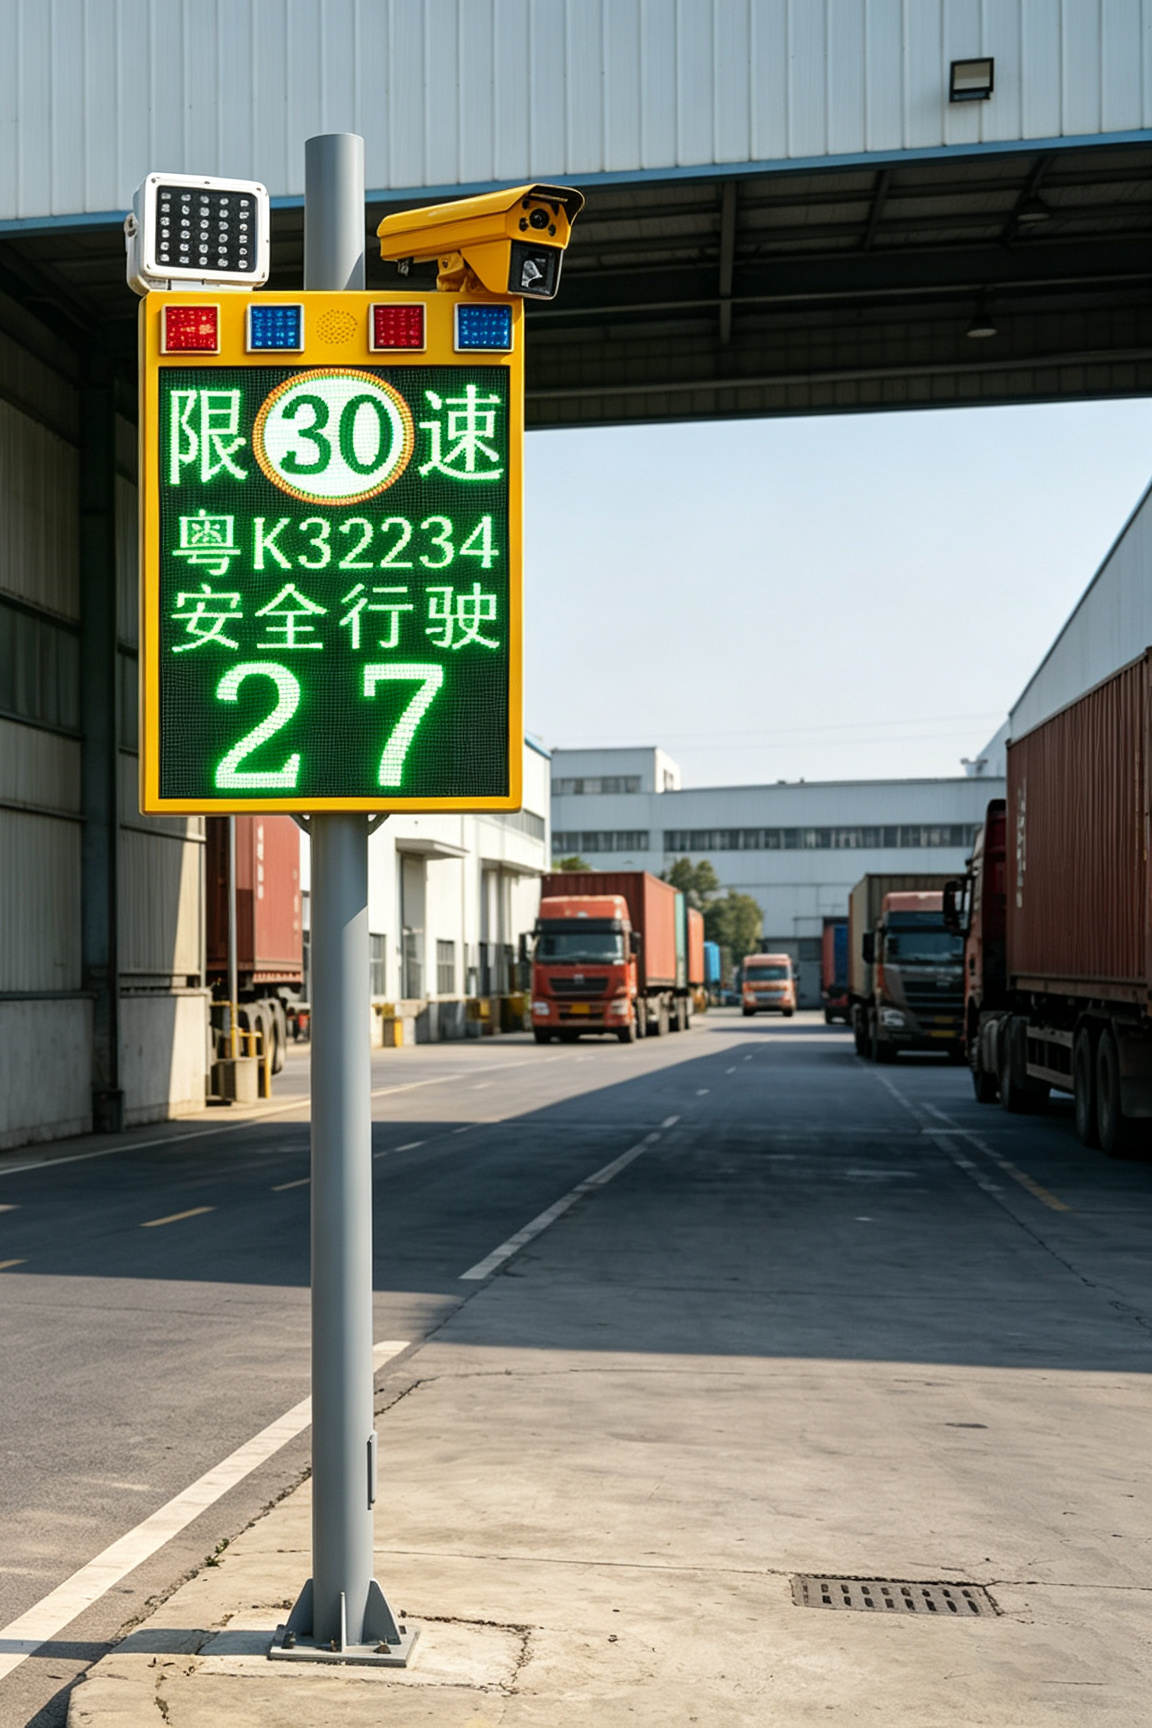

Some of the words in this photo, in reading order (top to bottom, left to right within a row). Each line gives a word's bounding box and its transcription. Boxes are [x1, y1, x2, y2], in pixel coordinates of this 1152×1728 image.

[170, 389, 247, 484] 限
[279, 394, 393, 475] 30
[418, 384, 504, 481] 速
[172, 583, 500, 652] 安全行驶
